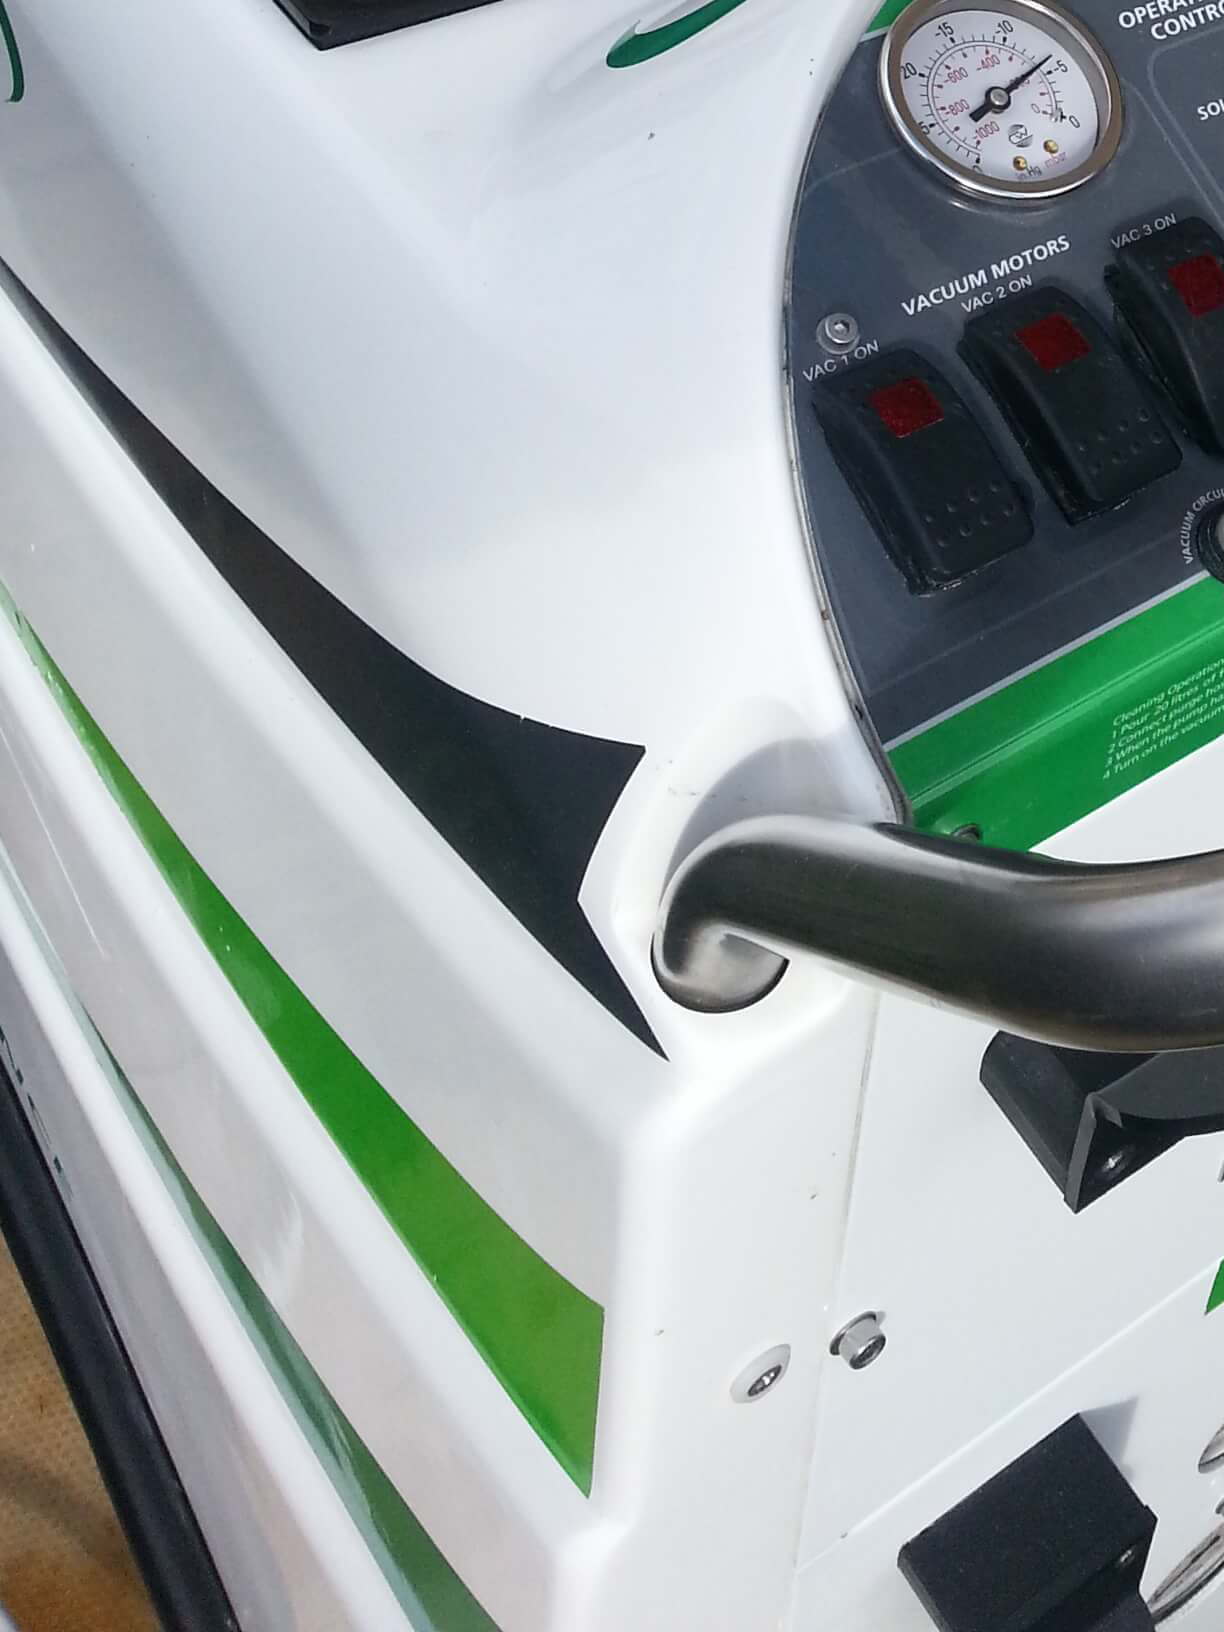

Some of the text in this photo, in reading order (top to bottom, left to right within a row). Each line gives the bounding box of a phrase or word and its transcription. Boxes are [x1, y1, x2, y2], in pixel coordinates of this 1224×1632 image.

[1110, 212, 1177, 250] VAC 3 ON
[901, 235, 1071, 316] VACUUM MOTORS
[960, 274, 1033, 314] VAC 2 ON
[802, 338, 880, 382] VAC 1 ON
[1180, 511, 1196, 565] VACUUM
